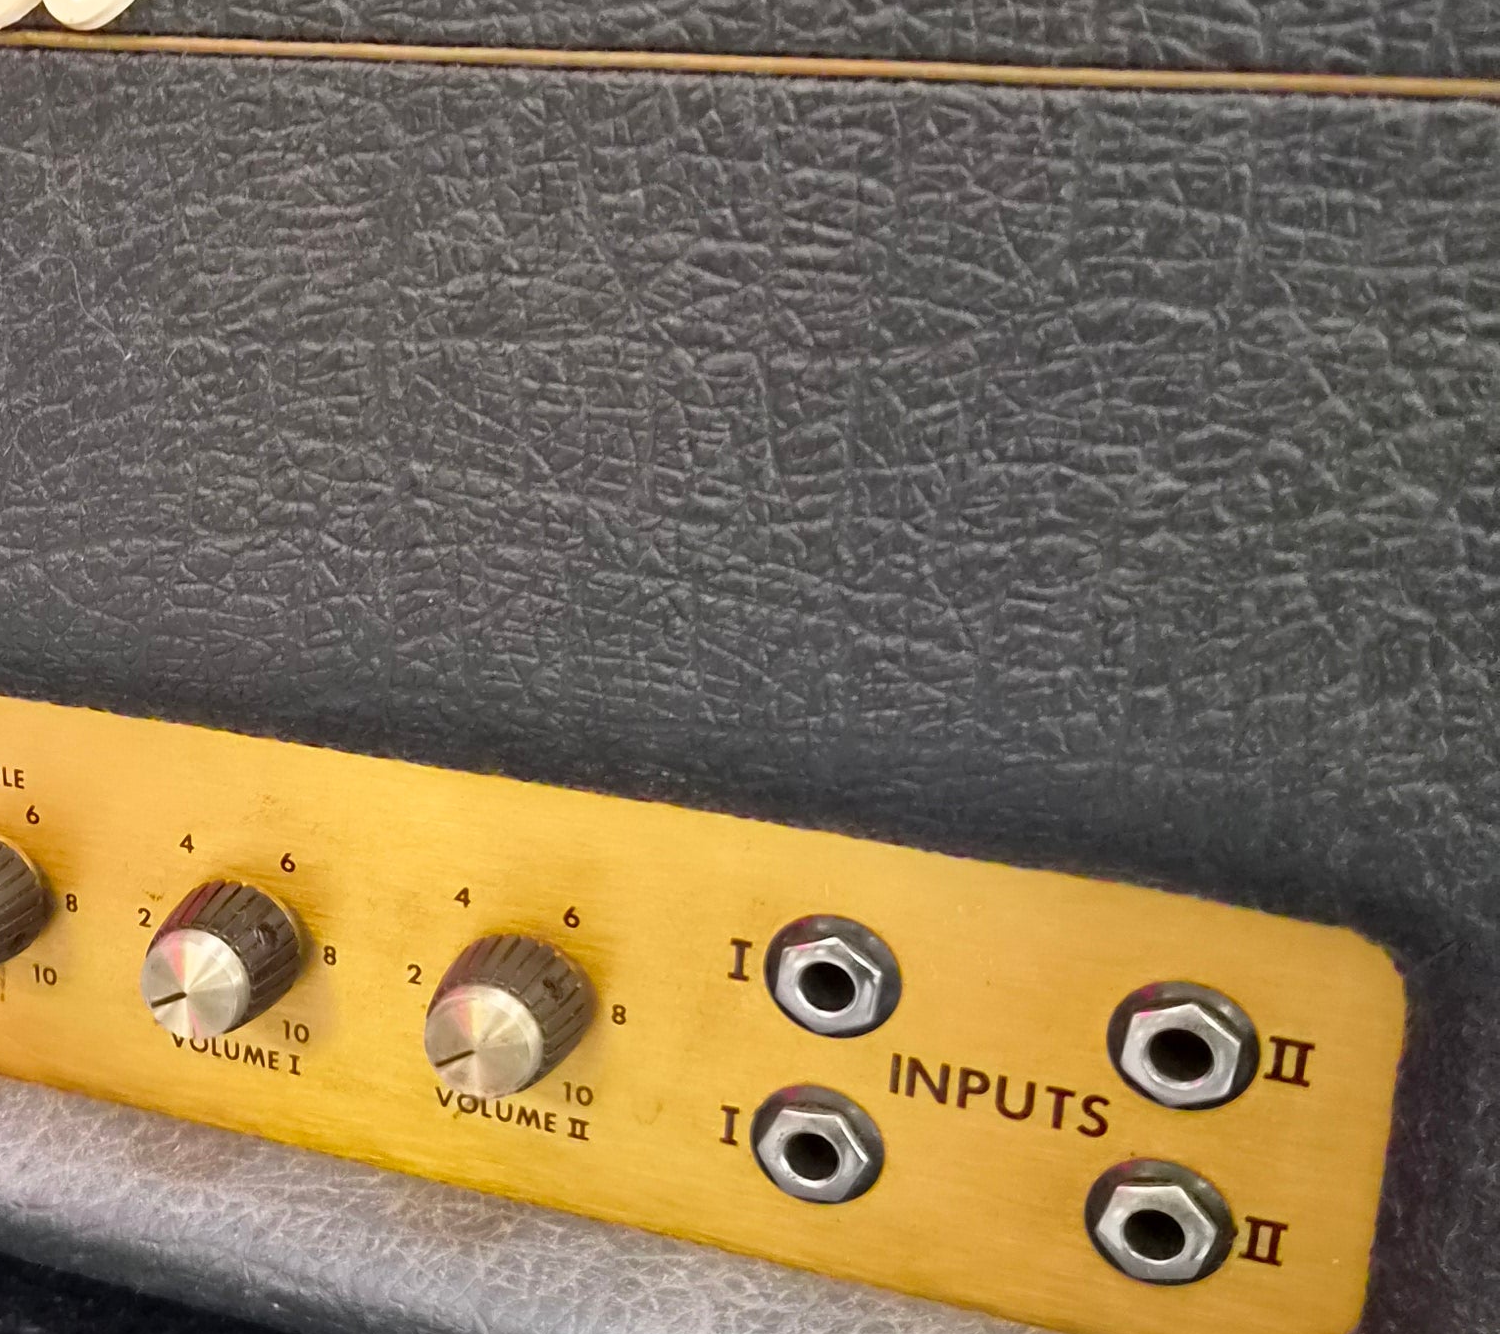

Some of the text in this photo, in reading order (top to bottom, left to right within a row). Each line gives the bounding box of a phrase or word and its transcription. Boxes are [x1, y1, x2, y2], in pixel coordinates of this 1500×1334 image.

[26, 805, 41, 825] 6
[180, 834, 195, 853] 4
[280, 852, 296, 873] 6
[65, 893, 79, 913] 8
[454, 887, 472, 908] 4
[138, 908, 152, 928] 2
[563, 906, 581, 928] 6
[323, 945, 338, 966] 8
[727, 938, 753, 982] I
[33, 963, 58, 986] 10
[407, 964, 423, 985] 2
[611, 1004, 627, 1026] 8
[282, 1019, 310, 1044] 10
[171, 1032, 302, 1076] VOLUME I
[1263, 1035, 1316, 1087] II
[562, 1081, 594, 1107] 10
[889, 1053, 1111, 1138] INPUTS
[434, 1086, 591, 1142] VOLUME II
[719, 1104, 740, 1146] I
[1239, 1215, 1289, 1266] II
